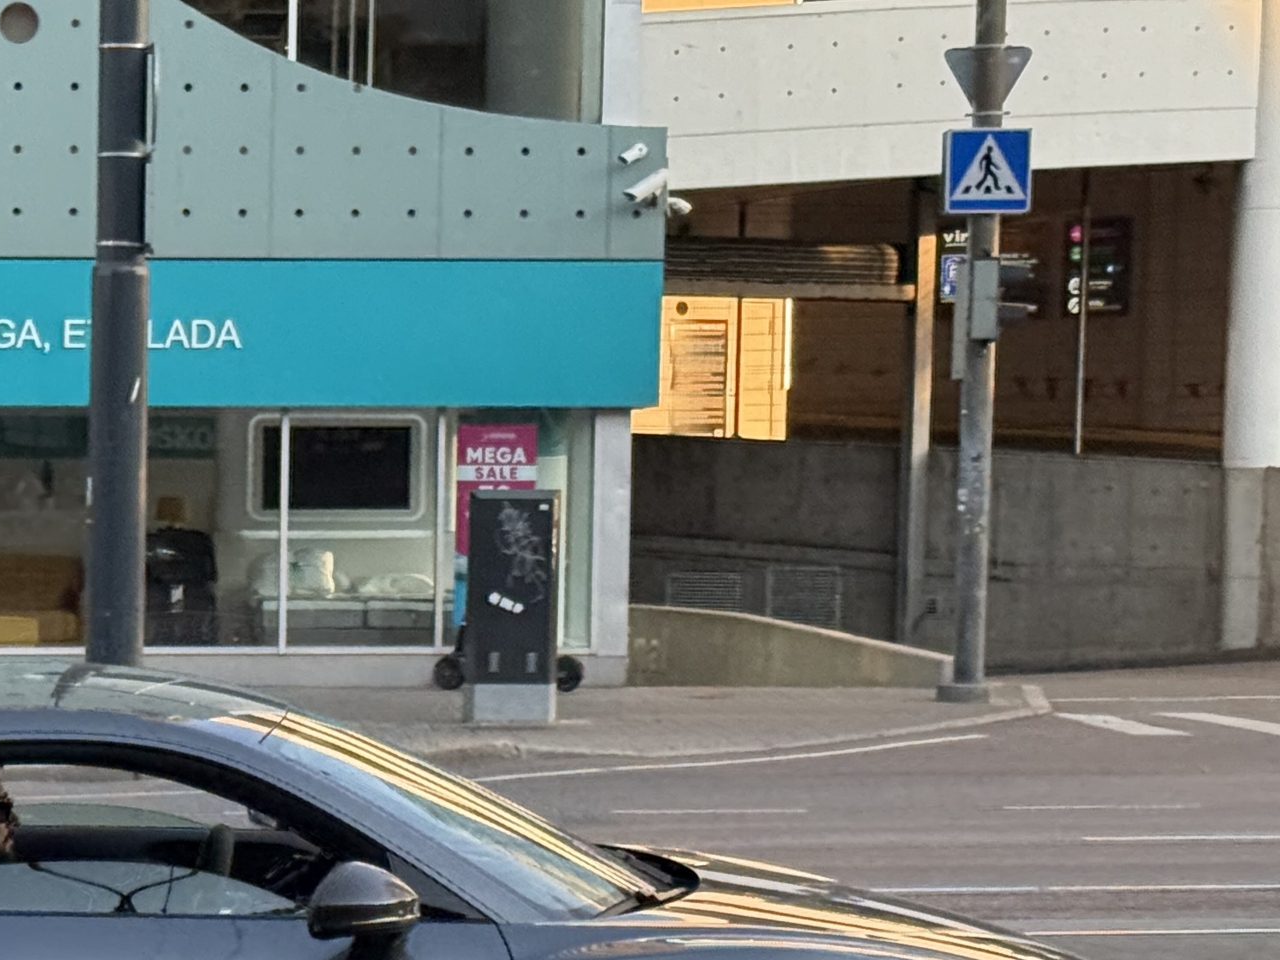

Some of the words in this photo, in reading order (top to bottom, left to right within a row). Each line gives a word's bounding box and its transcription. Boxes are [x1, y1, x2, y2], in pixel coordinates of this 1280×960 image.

[942, 229, 969, 243] vir
[63, 318, 92, 349] E
[146, 318, 242, 349] LADA
[466, 446, 527, 464] MEGA
[475, 466, 518, 480] SALE
